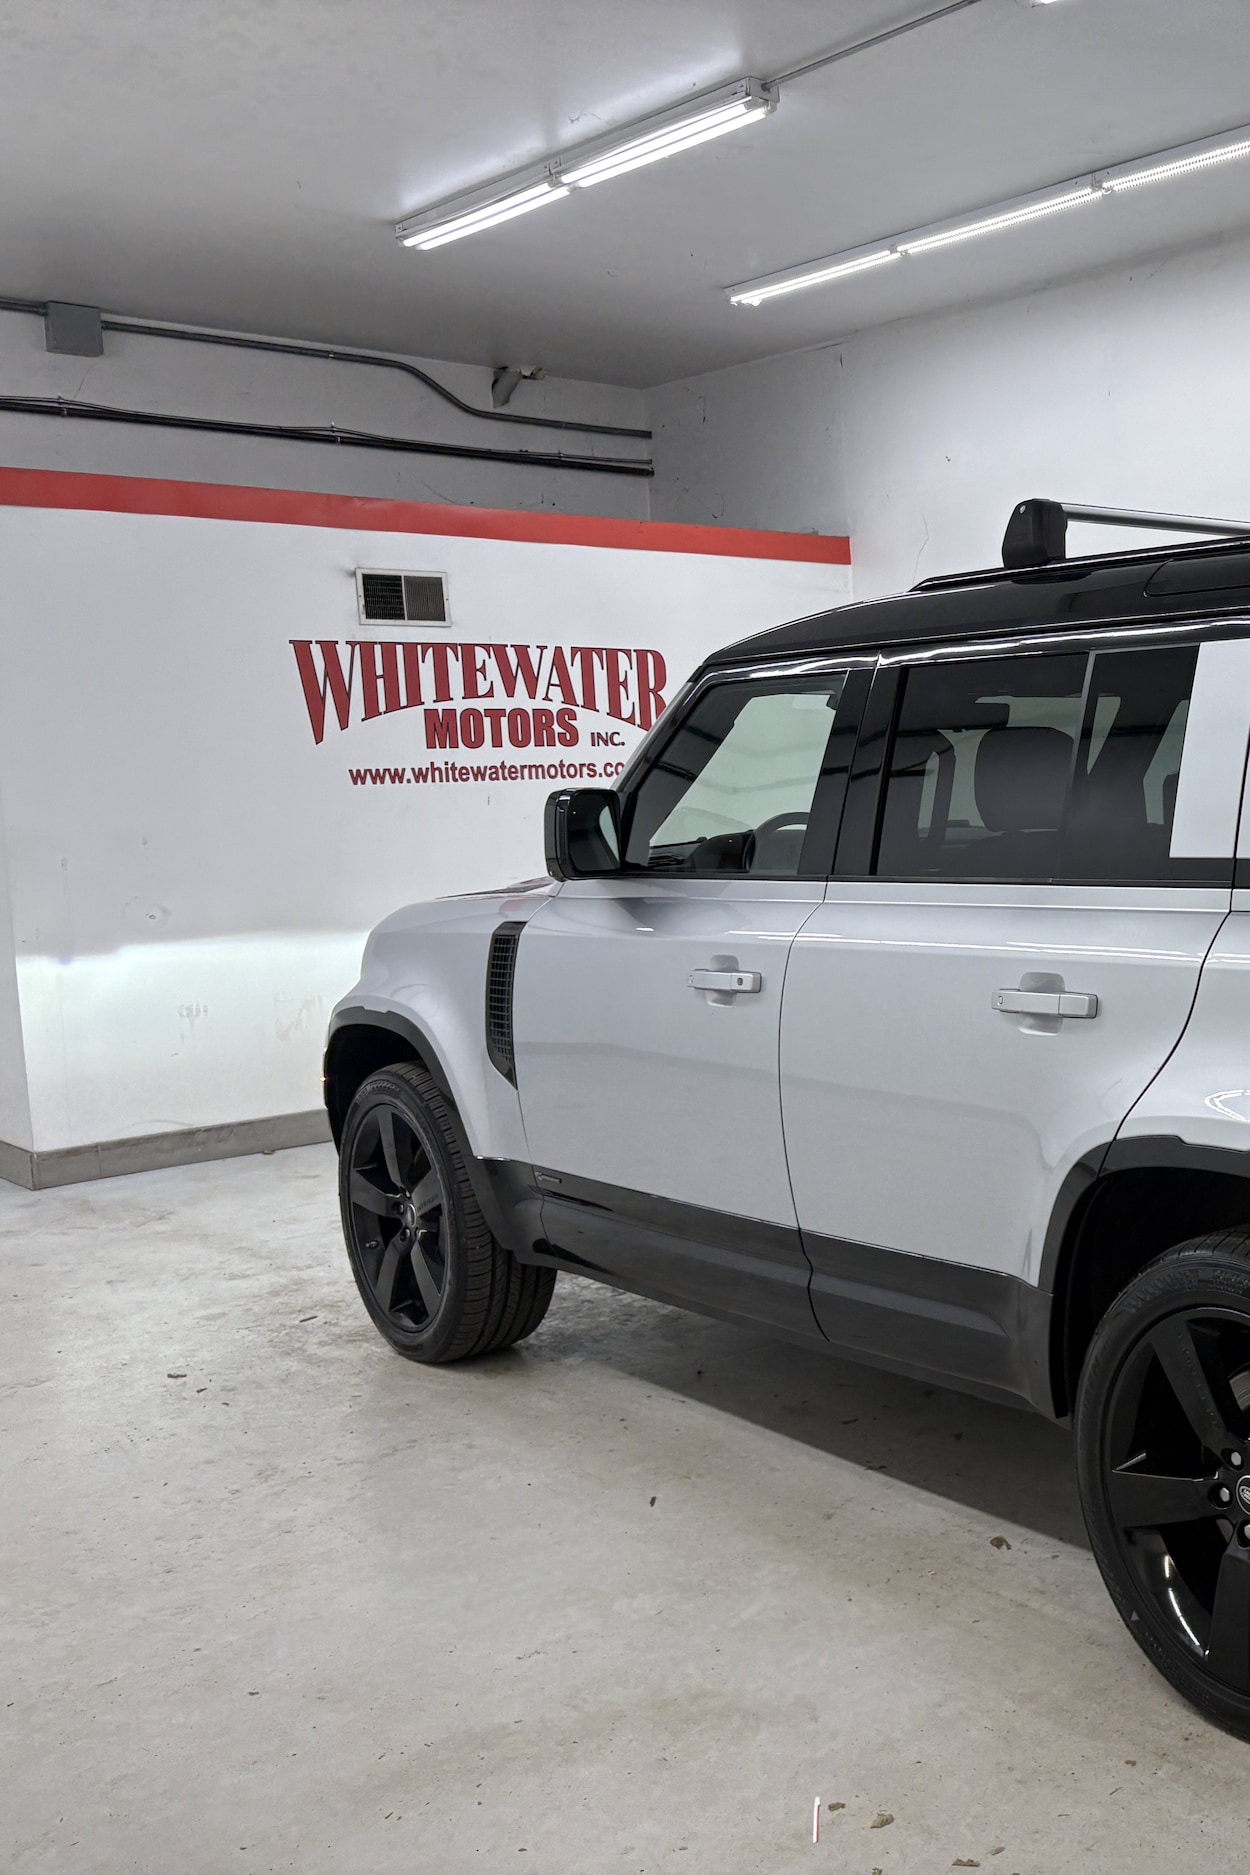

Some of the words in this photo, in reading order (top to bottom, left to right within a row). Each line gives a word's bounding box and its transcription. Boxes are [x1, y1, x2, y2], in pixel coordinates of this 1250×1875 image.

[289, 639, 668, 746] WHITEWATER
[423, 707, 580, 749] MOTORS
[590, 731, 626, 747] INC.
[348, 760, 626, 786] www.whitewatermotors.co
